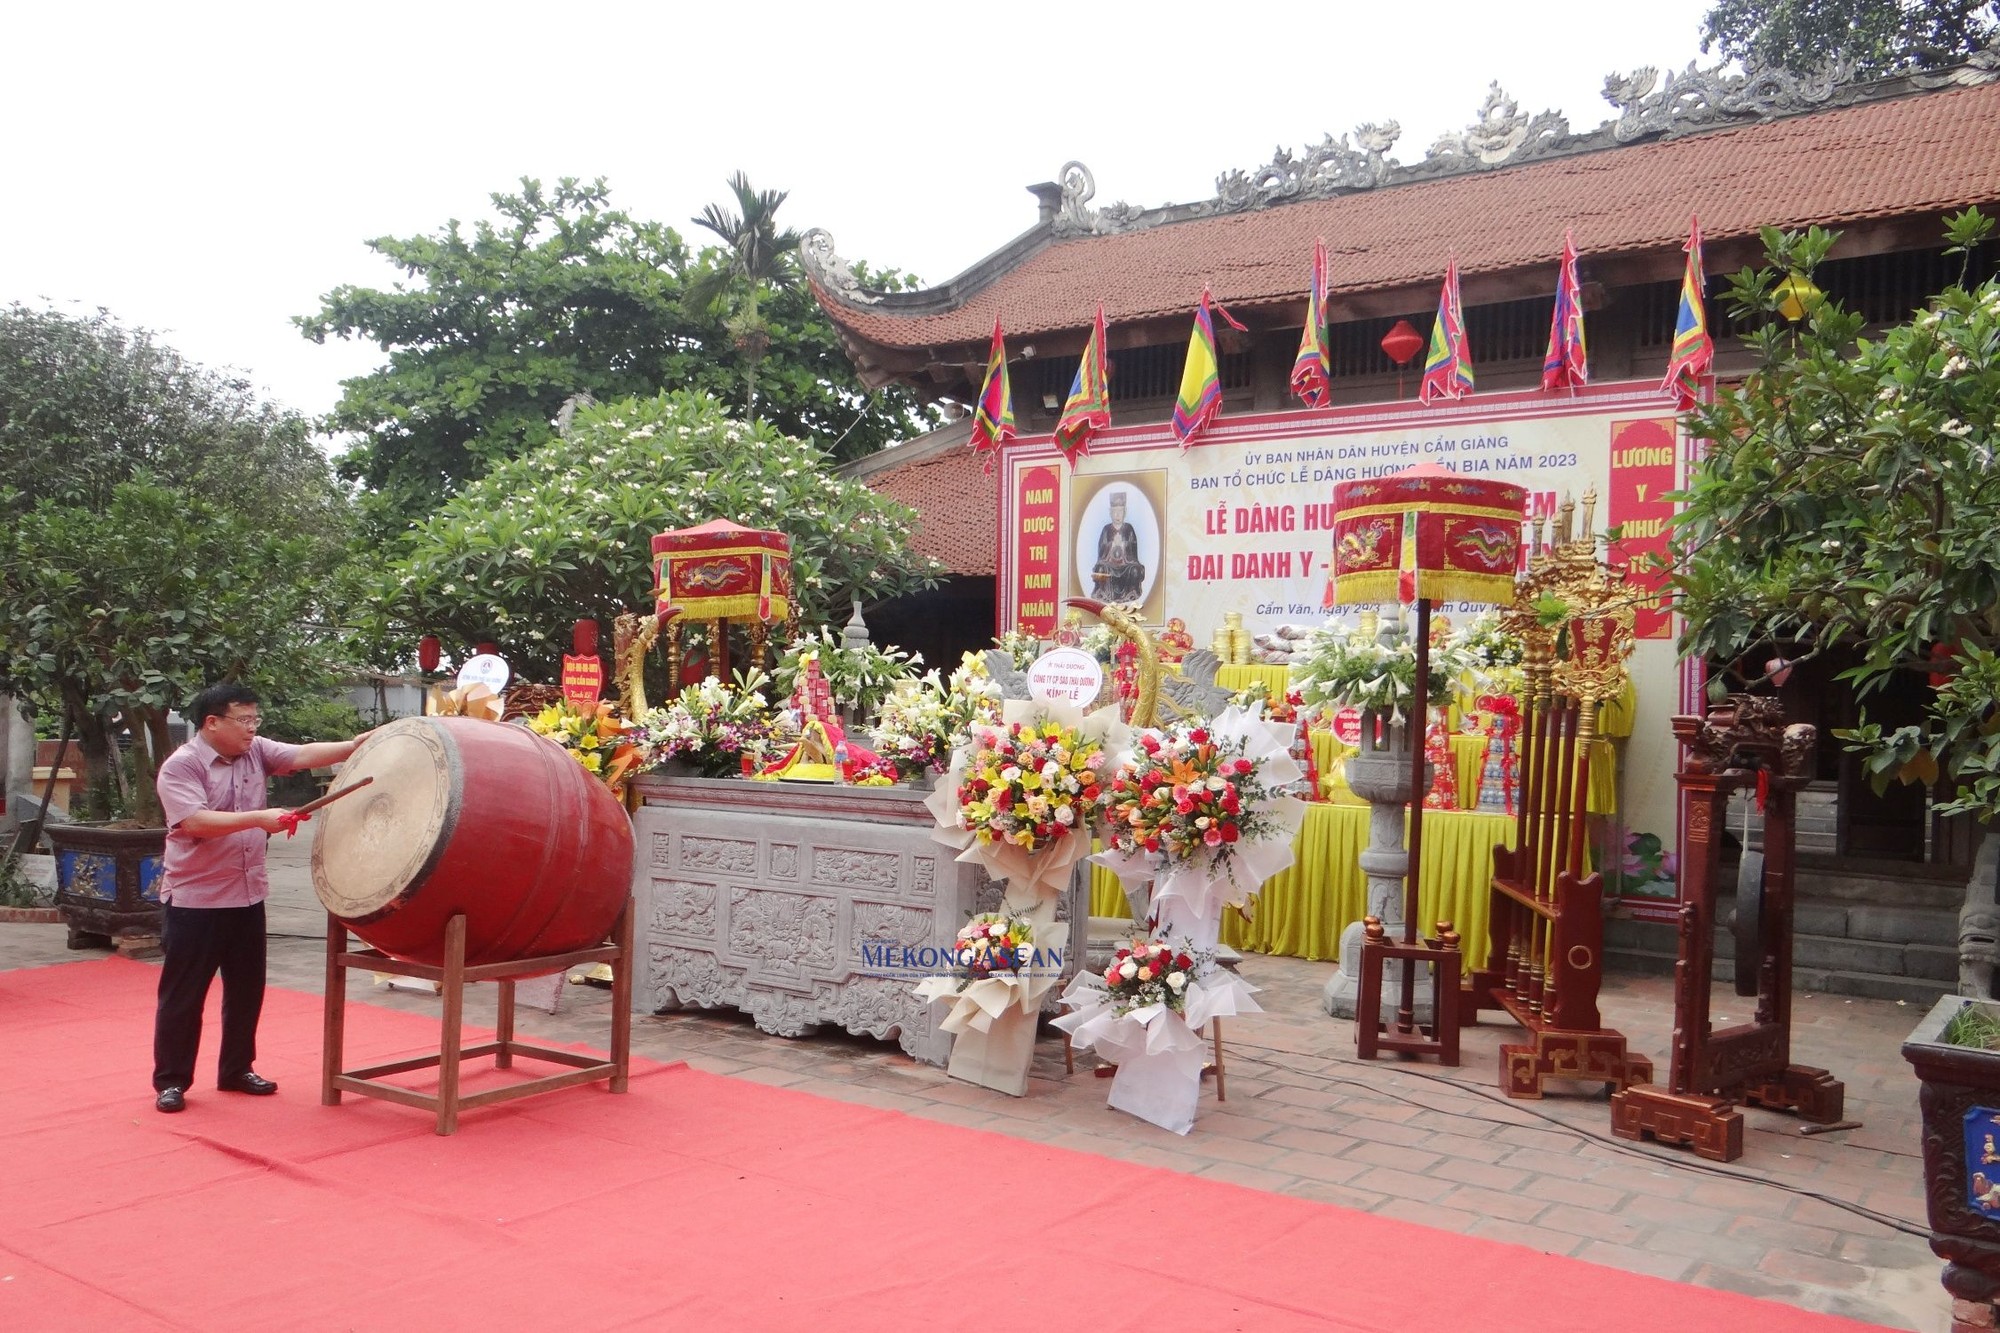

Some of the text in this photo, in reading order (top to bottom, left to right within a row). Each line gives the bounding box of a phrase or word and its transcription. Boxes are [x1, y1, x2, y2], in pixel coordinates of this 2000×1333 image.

[1245, 435, 1509, 466] ỦY BAN NHÂN DÂN HUYỆN CẨM GIÀNG
[1612, 446, 1673, 469] LƯƠNG
[1191, 477, 1219, 490] BAN
[1223, 469, 1242, 487] TỔ
[1245, 469, 1286, 486] CHỨC
[1290, 465, 1308, 483] LỄ
[1314, 466, 1356, 482] DÂNG
[1462, 459, 1490, 473] BIA
[1495, 454, 1532, 470] NĂM
[1538, 453, 1577, 468] 2023
[1025, 489, 1053, 505] NAM
[1636, 484, 1648, 502] Y
[1023, 516, 1054, 536] DƯỢC
[1206, 500, 1227, 535] LỄ
[1234, 502, 1295, 534] DÂNG
[1622, 518, 1662, 539] NHƯ
[1029, 545, 1048, 563] TRỊ
[1187, 554, 1224, 585] ĐẠI
[1231, 552, 1291, 579] DANH
[1299, 551, 1313, 577] Y
[1024, 574, 1052, 589] NAM
[1636, 583, 1661, 610] ẪU
[1021, 600, 1054, 617] NHÂN
[1256, 601, 1283, 615] Cẩm
